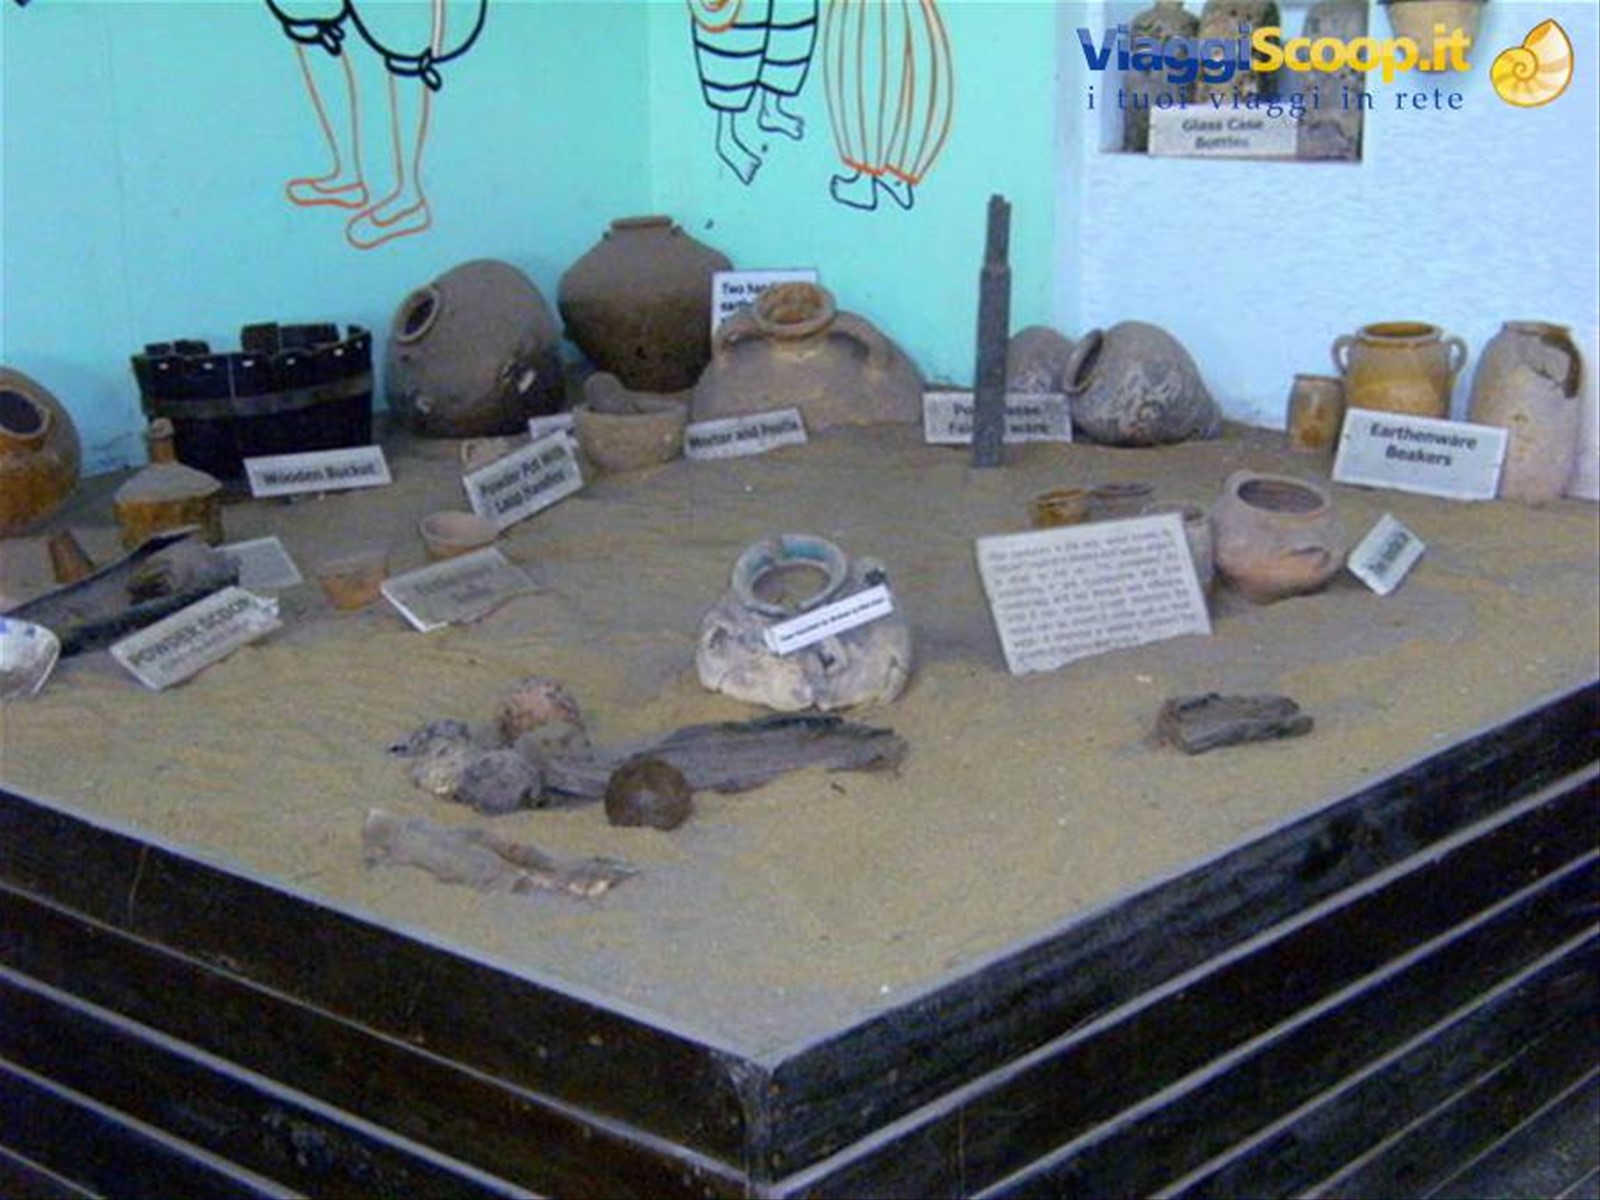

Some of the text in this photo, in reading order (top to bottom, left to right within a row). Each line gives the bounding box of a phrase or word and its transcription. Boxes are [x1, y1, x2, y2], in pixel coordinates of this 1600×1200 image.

[1182, 118, 1264, 131] Glass Case
[721, 283, 743, 295] Two
[688, 431, 731, 449] Mortar
[736, 424, 759, 441] and
[1370, 422, 1478, 451] Earthenware
[1385, 444, 1453, 467] Beakers
[264, 466, 323, 486] Wooden
[126, 625, 201, 668] POWDER
[197, 597, 251, 629] SCOOP
